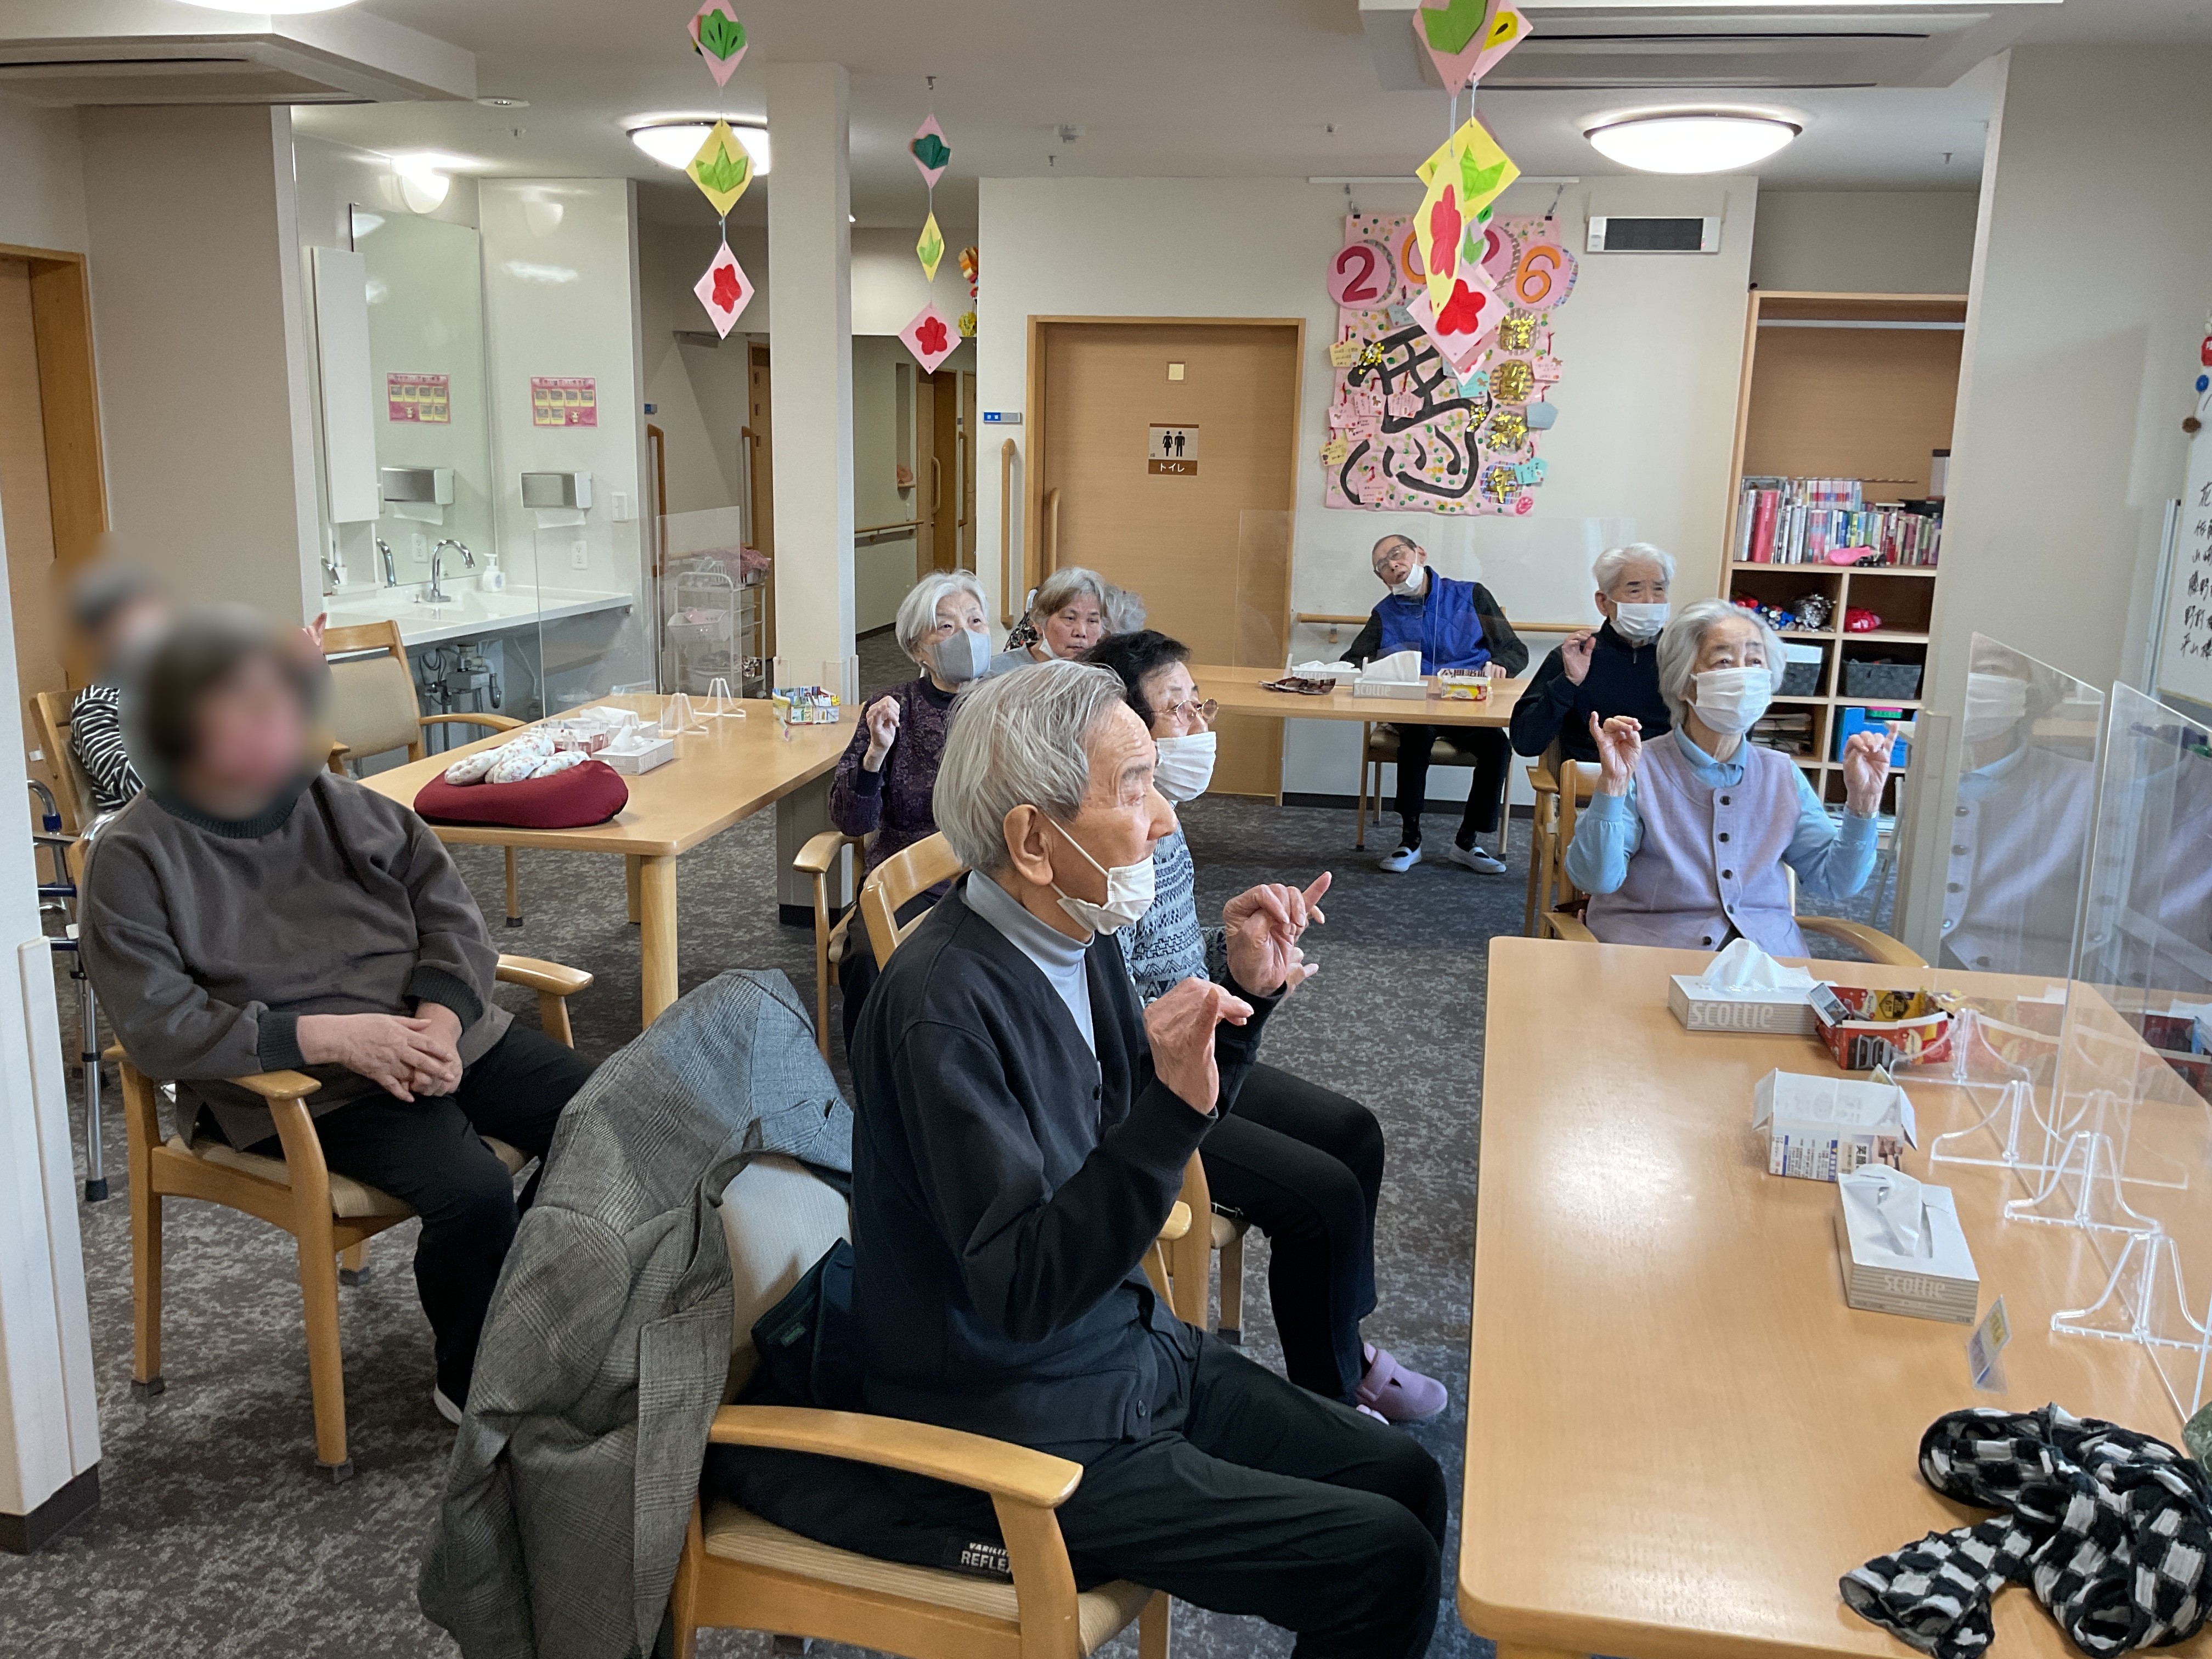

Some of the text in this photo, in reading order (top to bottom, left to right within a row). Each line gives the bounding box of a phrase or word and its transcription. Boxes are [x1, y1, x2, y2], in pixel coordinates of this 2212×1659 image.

[1160, 462, 1185, 472] トイレ
[1356, 683, 1391, 696] scottie
[1689, 1001, 1774, 1028] scottie
[1883, 1274, 1946, 1299] scottie
[969, 1542, 1009, 1556] VARILIT
